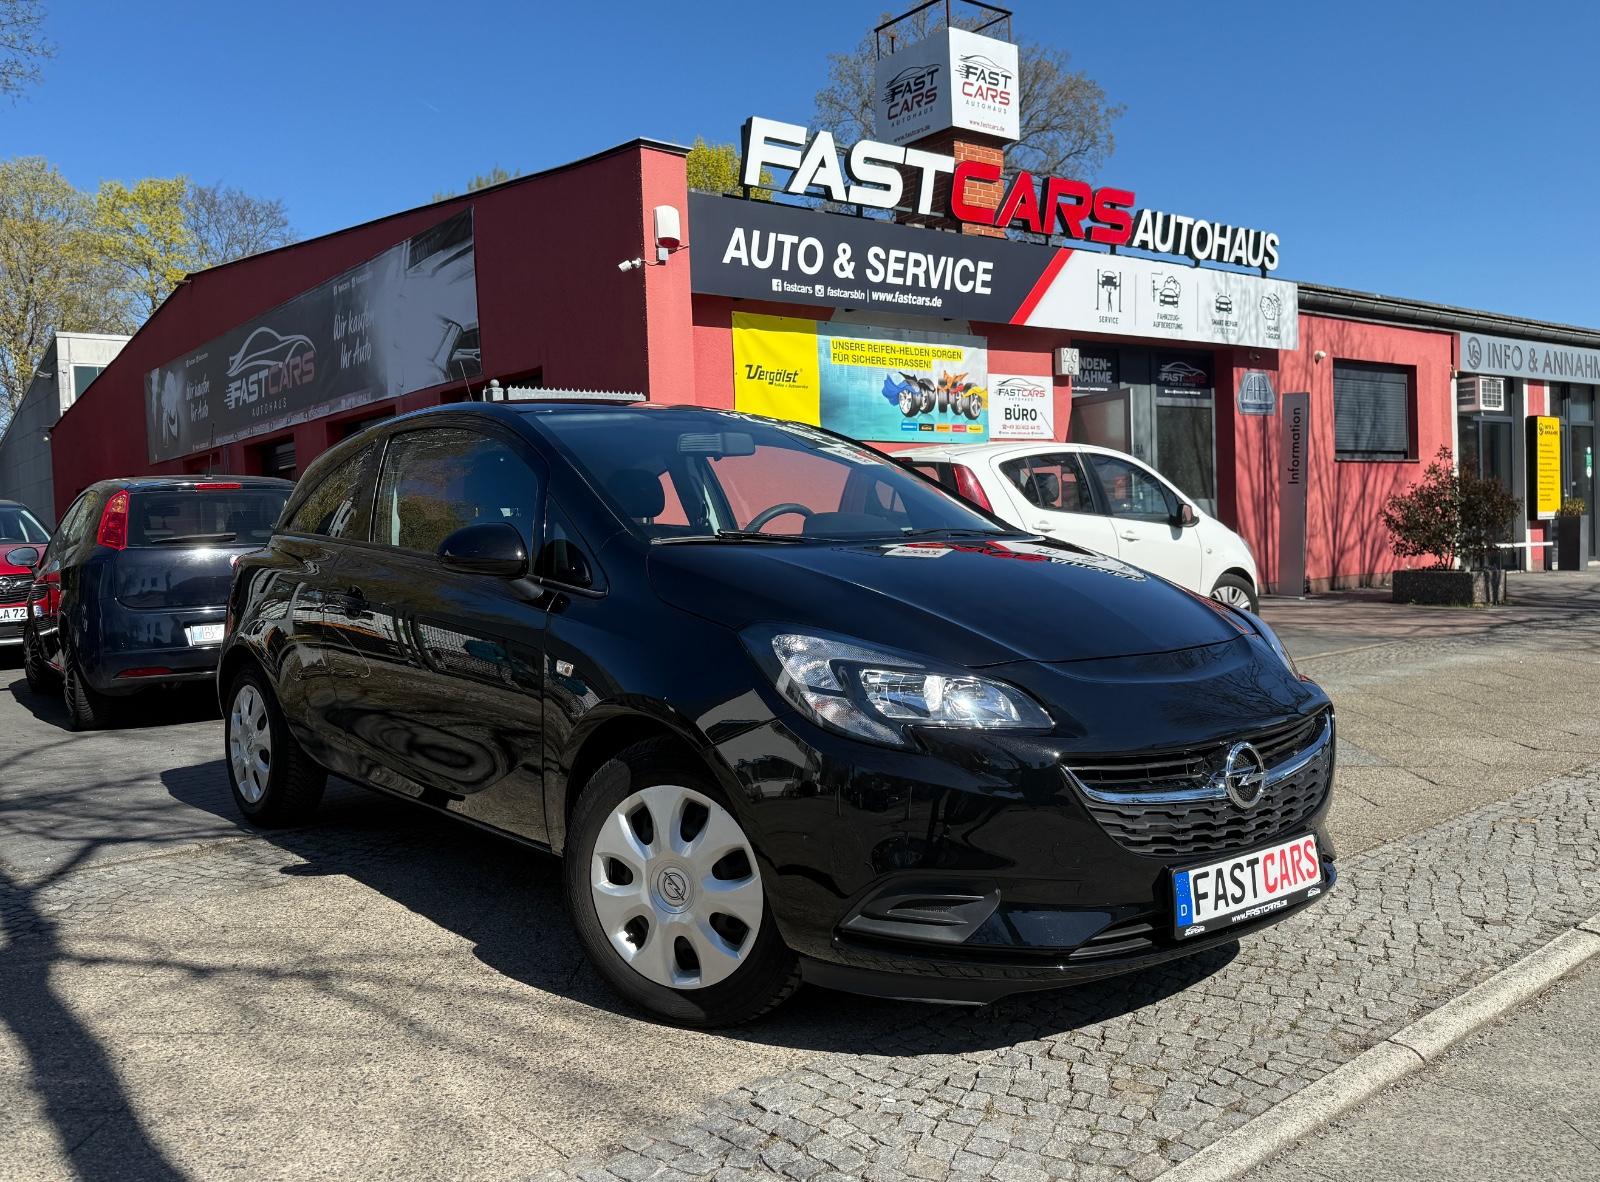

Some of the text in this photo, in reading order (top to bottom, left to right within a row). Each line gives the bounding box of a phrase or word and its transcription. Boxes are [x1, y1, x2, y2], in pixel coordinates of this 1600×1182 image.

[890, 67, 940, 101] FAST
[964, 64, 1012, 89] FAST
[887, 86, 938, 120] CARS
[962, 81, 1011, 107] CARS
[891, 106, 934, 128] AUTOHAUS
[965, 101, 1007, 115] AUTOHAUS
[1131, 208, 1280, 271] AUTOHAUS
[722, 227, 994, 295] AUTO & SERVICE
[783, 281, 943, 308] fastcars fastcarsbln www.fastcars.de
[1098, 315, 1119, 325] SERVICE
[832, 340, 962, 360] UNSERE REIFEN-HELDEN SORGEN
[832, 351, 850, 362] FÜR
[888, 357, 932, 369] STRASSEN!
[1062, 349, 1078, 363] 26
[1487, 342, 1523, 371] INFO
[1528, 347, 1538, 373] &
[744, 364, 799, 385] Vergölst
[251, 397, 287, 417] AUTOHAUS
[1004, 404, 1038, 421] BÜRO
[1287, 407, 1301, 485] Information
[0, 609, 10, 619] A
[1180, 839, 1318, 917] D FASTCARS
